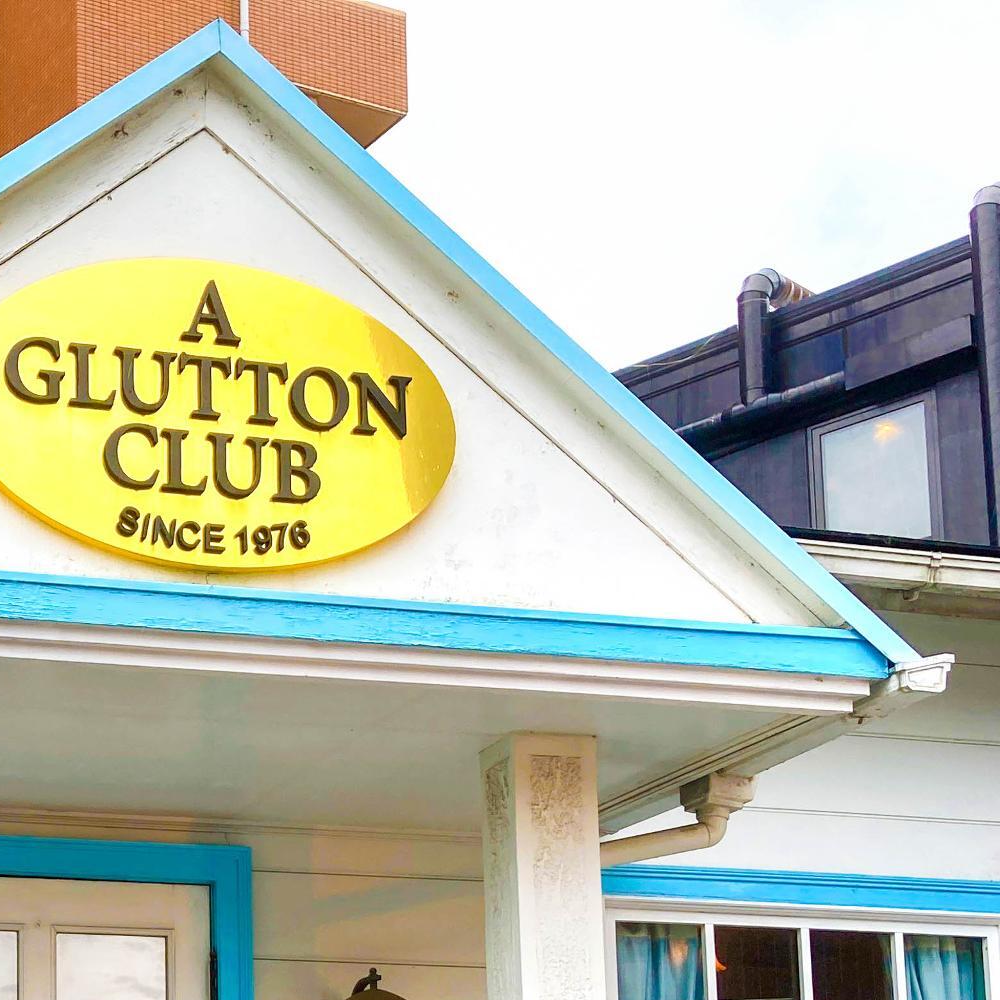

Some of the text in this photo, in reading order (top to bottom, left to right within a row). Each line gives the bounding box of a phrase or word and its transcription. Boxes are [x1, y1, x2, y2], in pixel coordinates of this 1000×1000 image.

[180, 279, 241, 347] A
[4, 336, 413, 439] GLUTTON
[101, 422, 321, 504] CLUB
[114, 505, 311, 556] SINCE 1976
